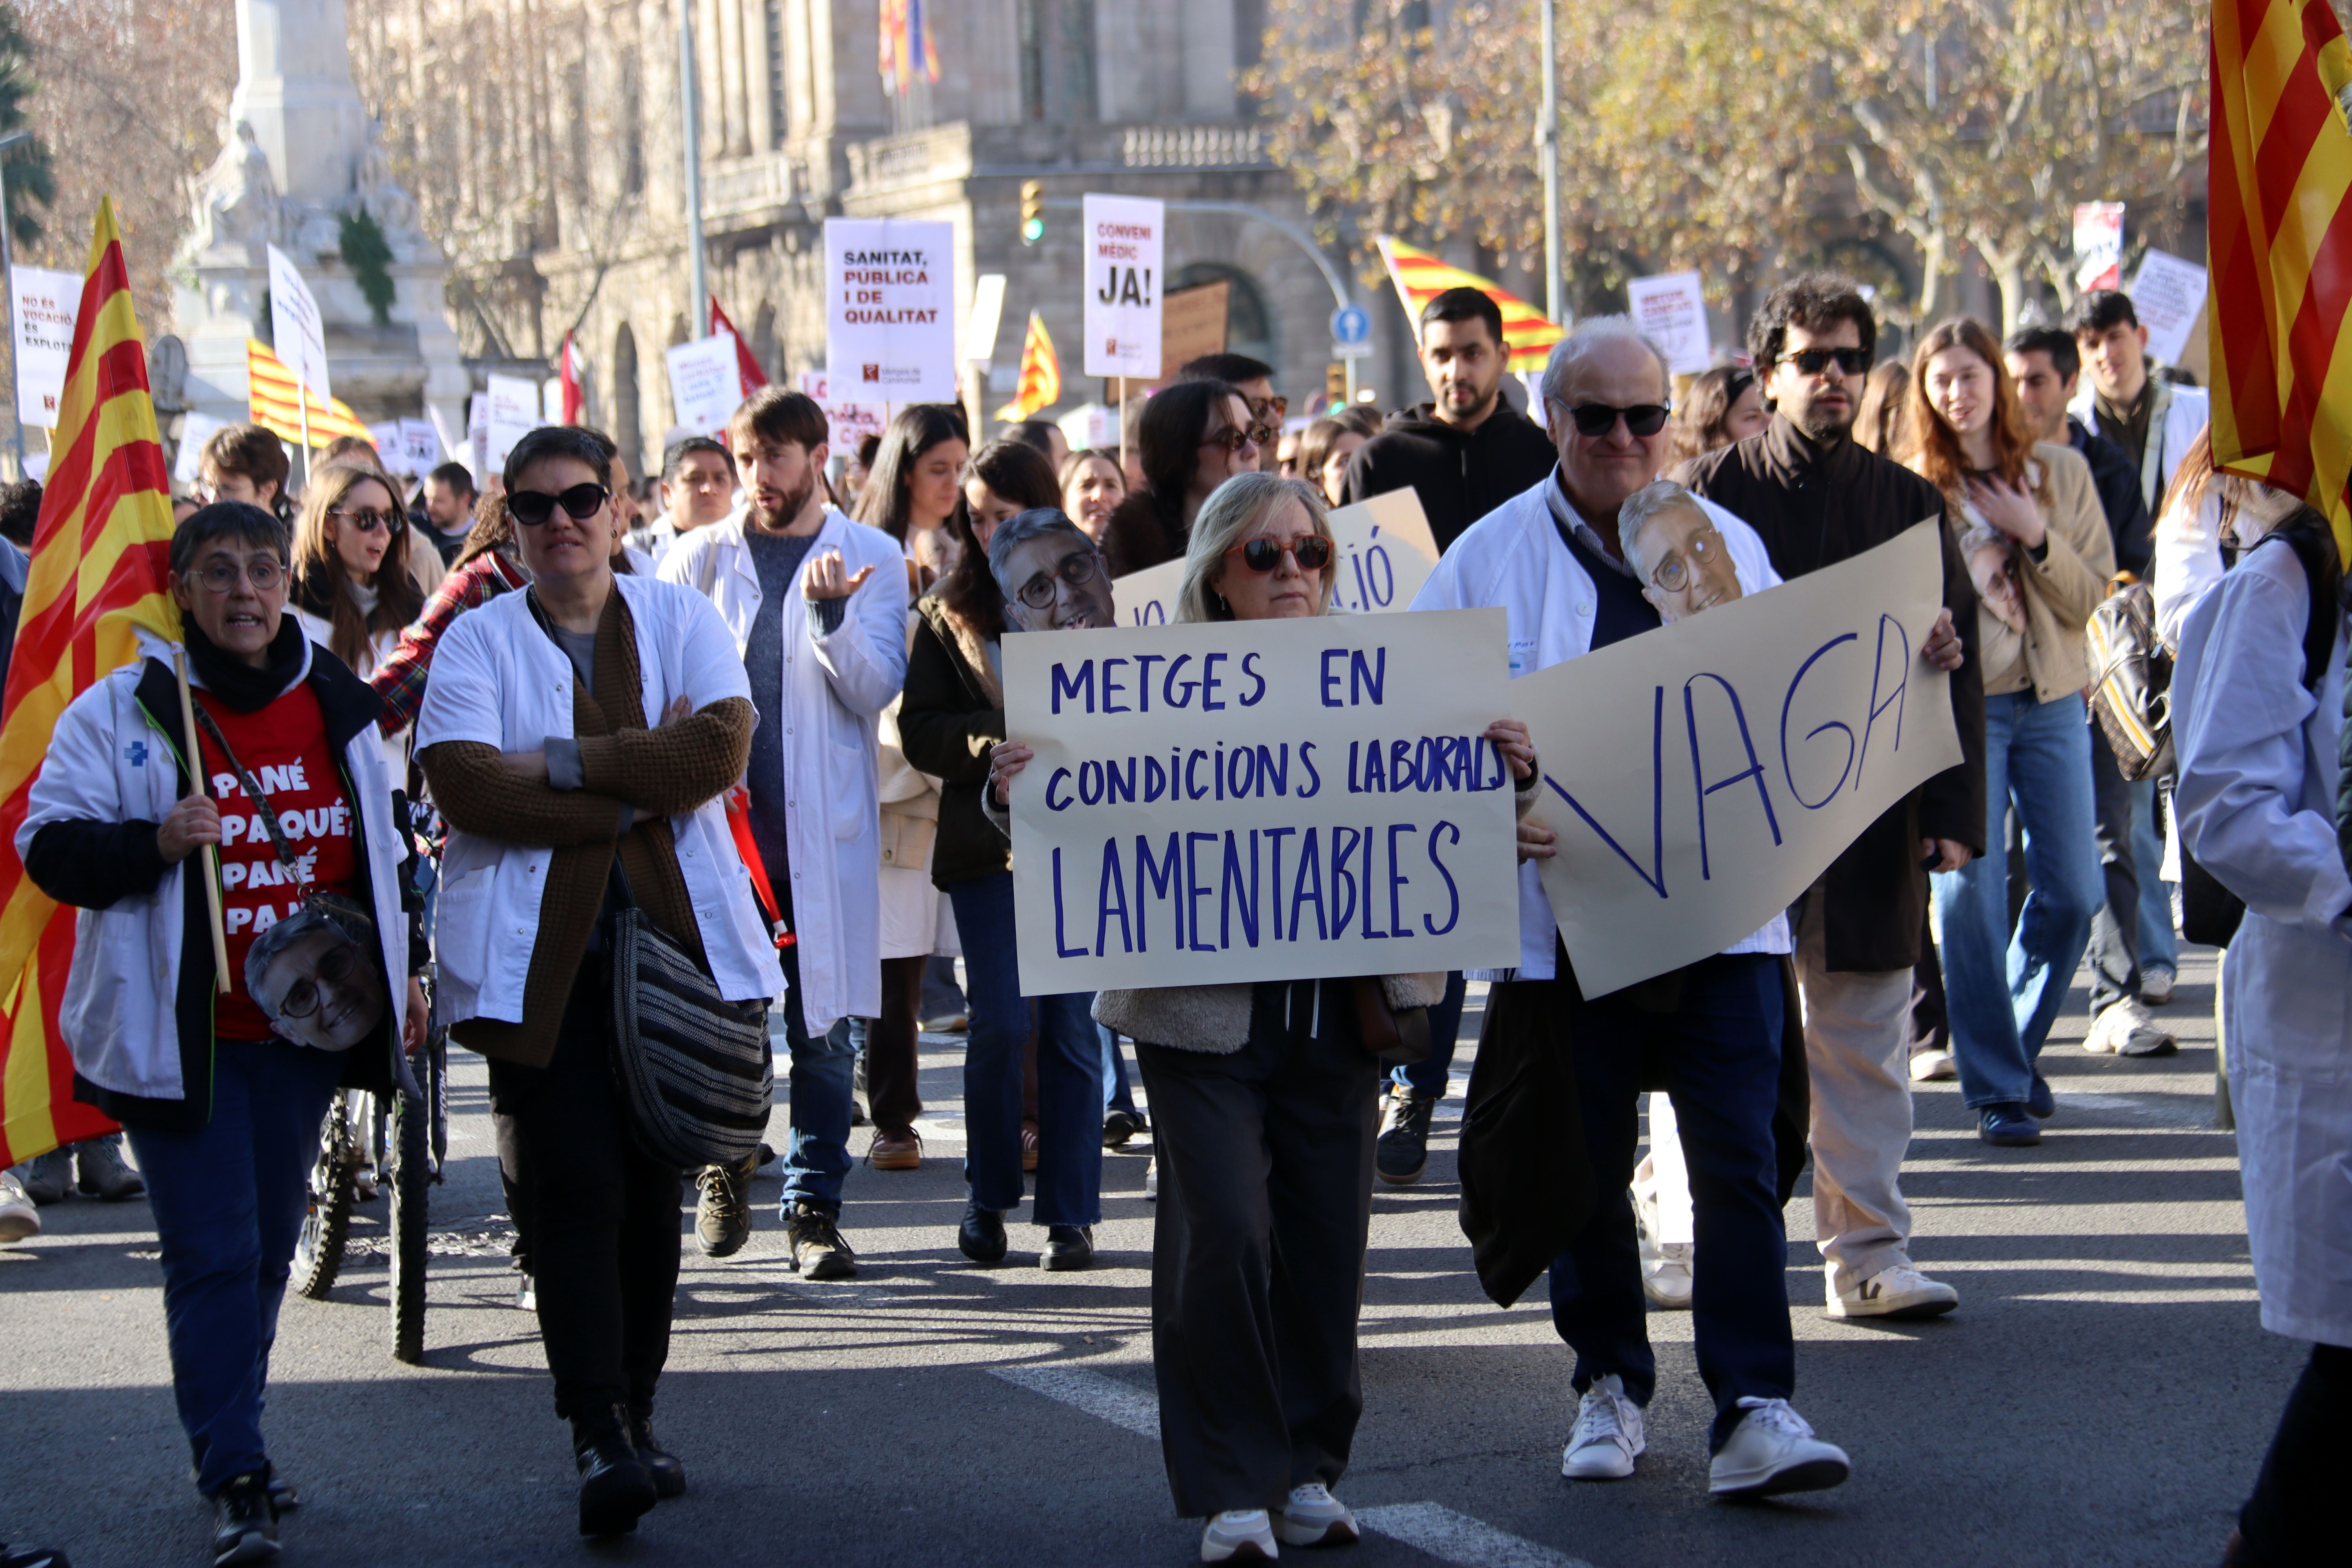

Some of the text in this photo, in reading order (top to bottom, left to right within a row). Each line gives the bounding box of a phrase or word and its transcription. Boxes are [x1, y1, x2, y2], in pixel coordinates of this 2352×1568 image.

[1098, 223, 1151, 240] CONVENI
[844, 252, 927, 267] SANITAT,
[1099, 242, 1138, 260] MÈDIC
[845, 268, 928, 285] PÚBLICA
[1099, 267, 1151, 307] JA!
[22, 296, 56, 310] NO ÉS
[845, 291, 882, 303] I DE
[845, 310, 938, 324] QUALITAT
[24, 321, 38, 334] ÉS
[1051, 647, 1386, 714] METGES EN
[1543, 613, 1910, 899] VAGA
[1045, 735, 1505, 812] CONDICIONS LABORALS
[1053, 820, 1460, 958] LAMENTABLES
